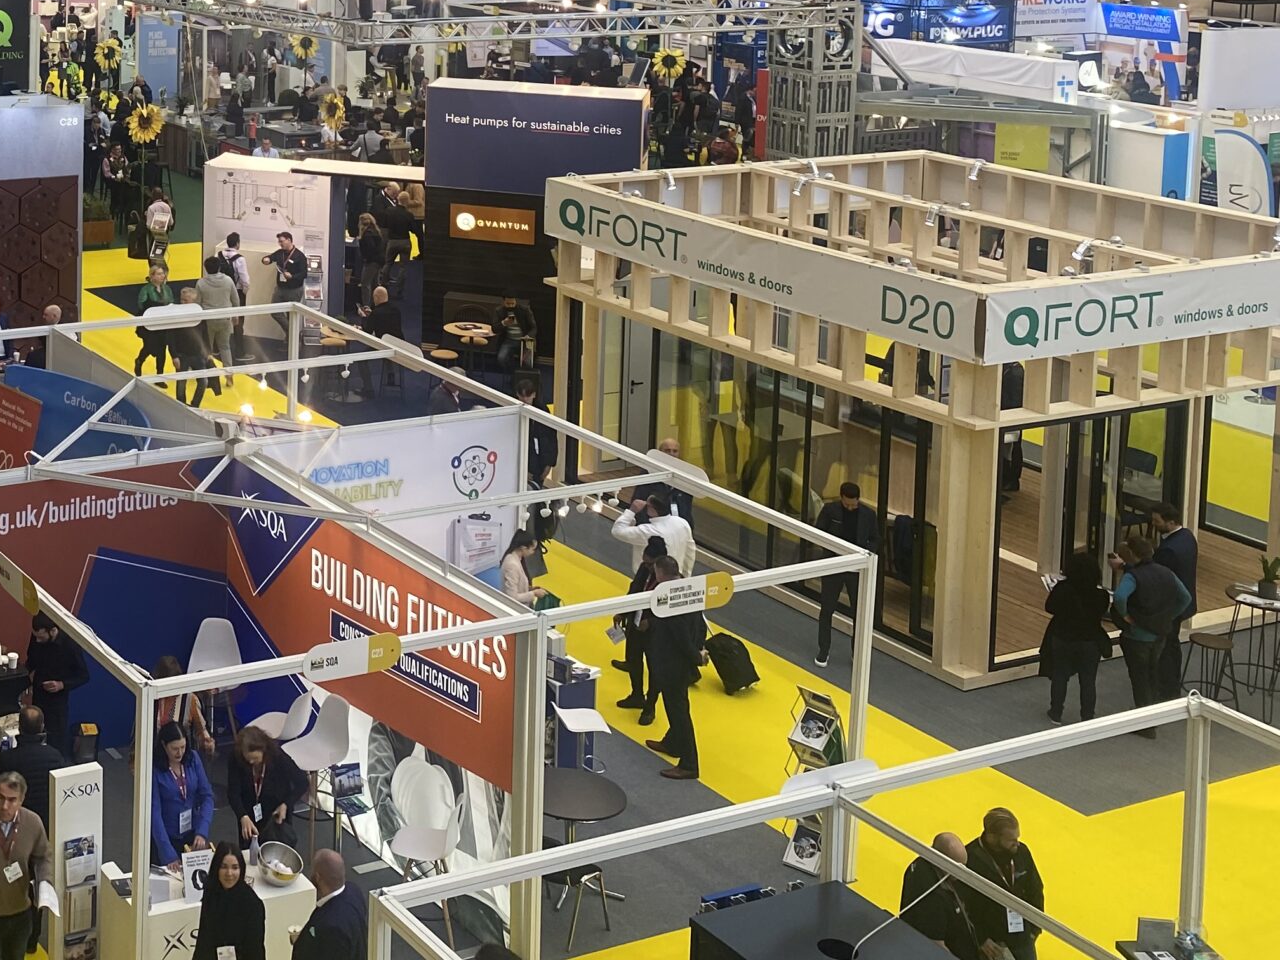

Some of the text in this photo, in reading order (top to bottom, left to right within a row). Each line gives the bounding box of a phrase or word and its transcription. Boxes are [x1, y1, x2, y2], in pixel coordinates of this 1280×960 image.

[1028, 7, 1087, 16] Protection Systems
[1110, 10, 1172, 23] AWARD WINNING
[445, 113, 622, 136] Heat pumps for sustainable cities
[476, 219, 529, 232] QVANTUM
[558, 197, 688, 263] QFORT
[697, 258, 794, 296] windows & doors
[880, 284, 955, 341] D20
[1003, 290, 1164, 348] QFORT
[1173, 300, 1269, 325] windows & doors
[63, 391, 129, 426] Carbon egative
[307, 458, 389, 485] NOVATION
[258, 511, 288, 542] SQA
[310, 547, 400, 630] BUILDING
[325, 647, 384, 667] SQA C23
[399, 653, 470, 703] QUALIFICATIONS
[77, 782, 101, 797] SQA
